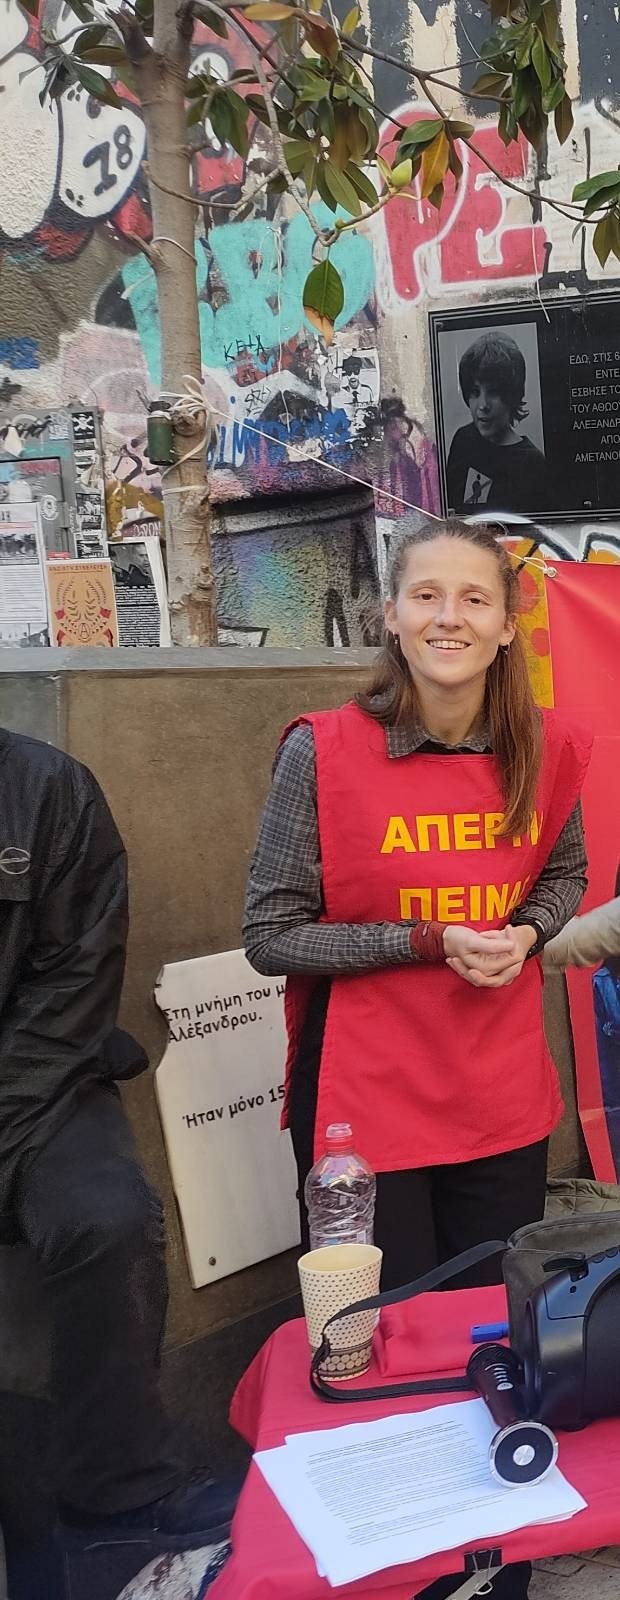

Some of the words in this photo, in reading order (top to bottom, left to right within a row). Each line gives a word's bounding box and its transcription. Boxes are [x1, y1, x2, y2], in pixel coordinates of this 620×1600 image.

[593, 352, 613, 363] ΣΤΙΣ
[571, 386, 607, 397] ΕΣΒΗΣΕ
[572, 403, 591, 414] ΤΟΥ
[575, 451, 620, 463] ΑΜΕΤΑΝΟ
[162, 1007, 191, 1021] Στη
[195, 994, 242, 1017] μνήμη
[246, 987, 271, 1002] του
[168, 1011, 263, 1043] Αλέξανδρου.
[228, 1095, 264, 1119] μόνο
[268, 1084, 286, 1103] 15
